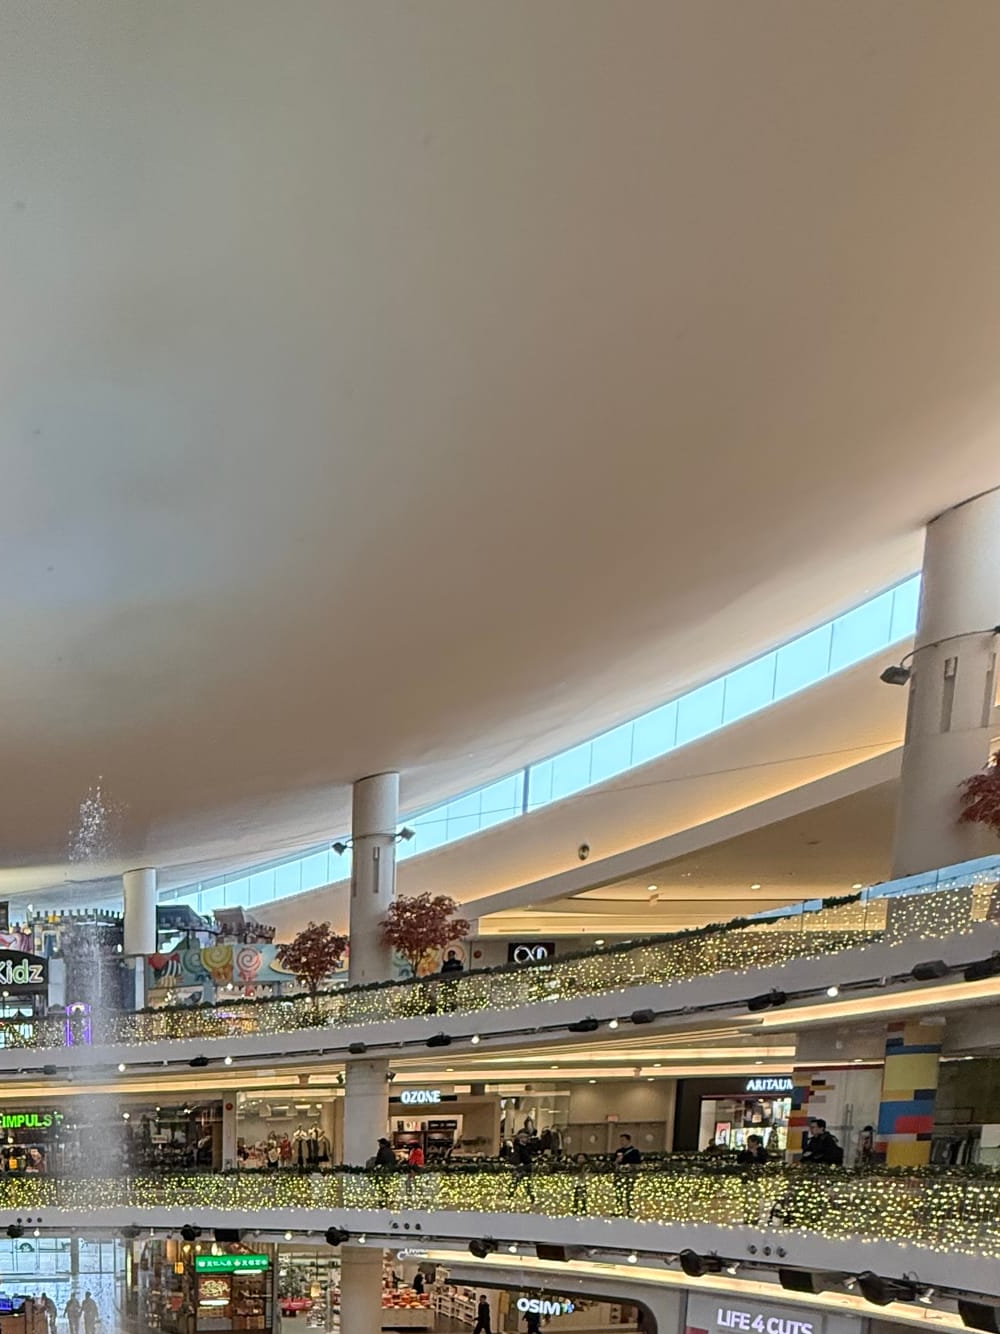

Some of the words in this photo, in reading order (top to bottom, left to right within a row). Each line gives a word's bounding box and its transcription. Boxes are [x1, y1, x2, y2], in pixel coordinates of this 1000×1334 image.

[400, 1090, 441, 1104] OZONE
[517, 1298, 561, 1316] OSIM
[716, 1308, 751, 1330] LIFE
[751, 1314, 765, 1333] 4
